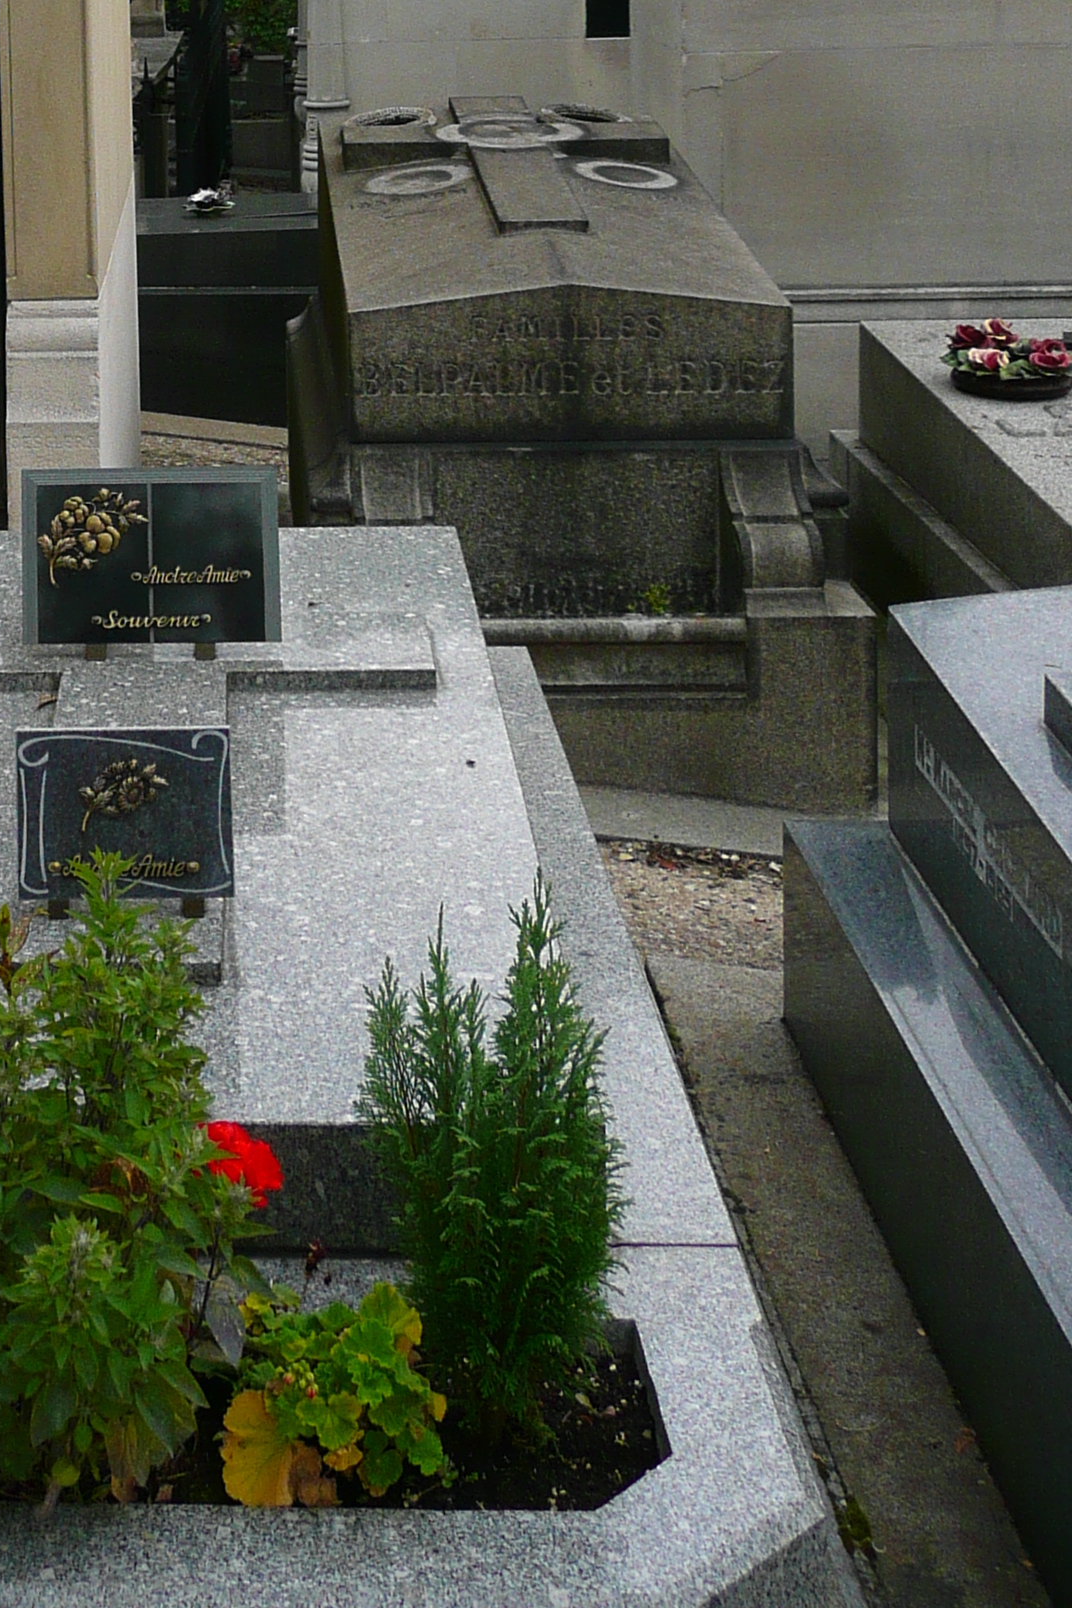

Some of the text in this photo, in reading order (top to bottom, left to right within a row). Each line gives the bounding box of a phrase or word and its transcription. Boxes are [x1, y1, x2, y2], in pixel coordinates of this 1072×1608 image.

[470, 314, 665, 344] FAMILLES
[592, 364, 630, 396] et
[644, 359, 785, 396] LEDEZ
[197, 564, 239, 584] Amie
[103, 610, 200, 629] Souvenir
[132, 853, 186, 877] Amie
